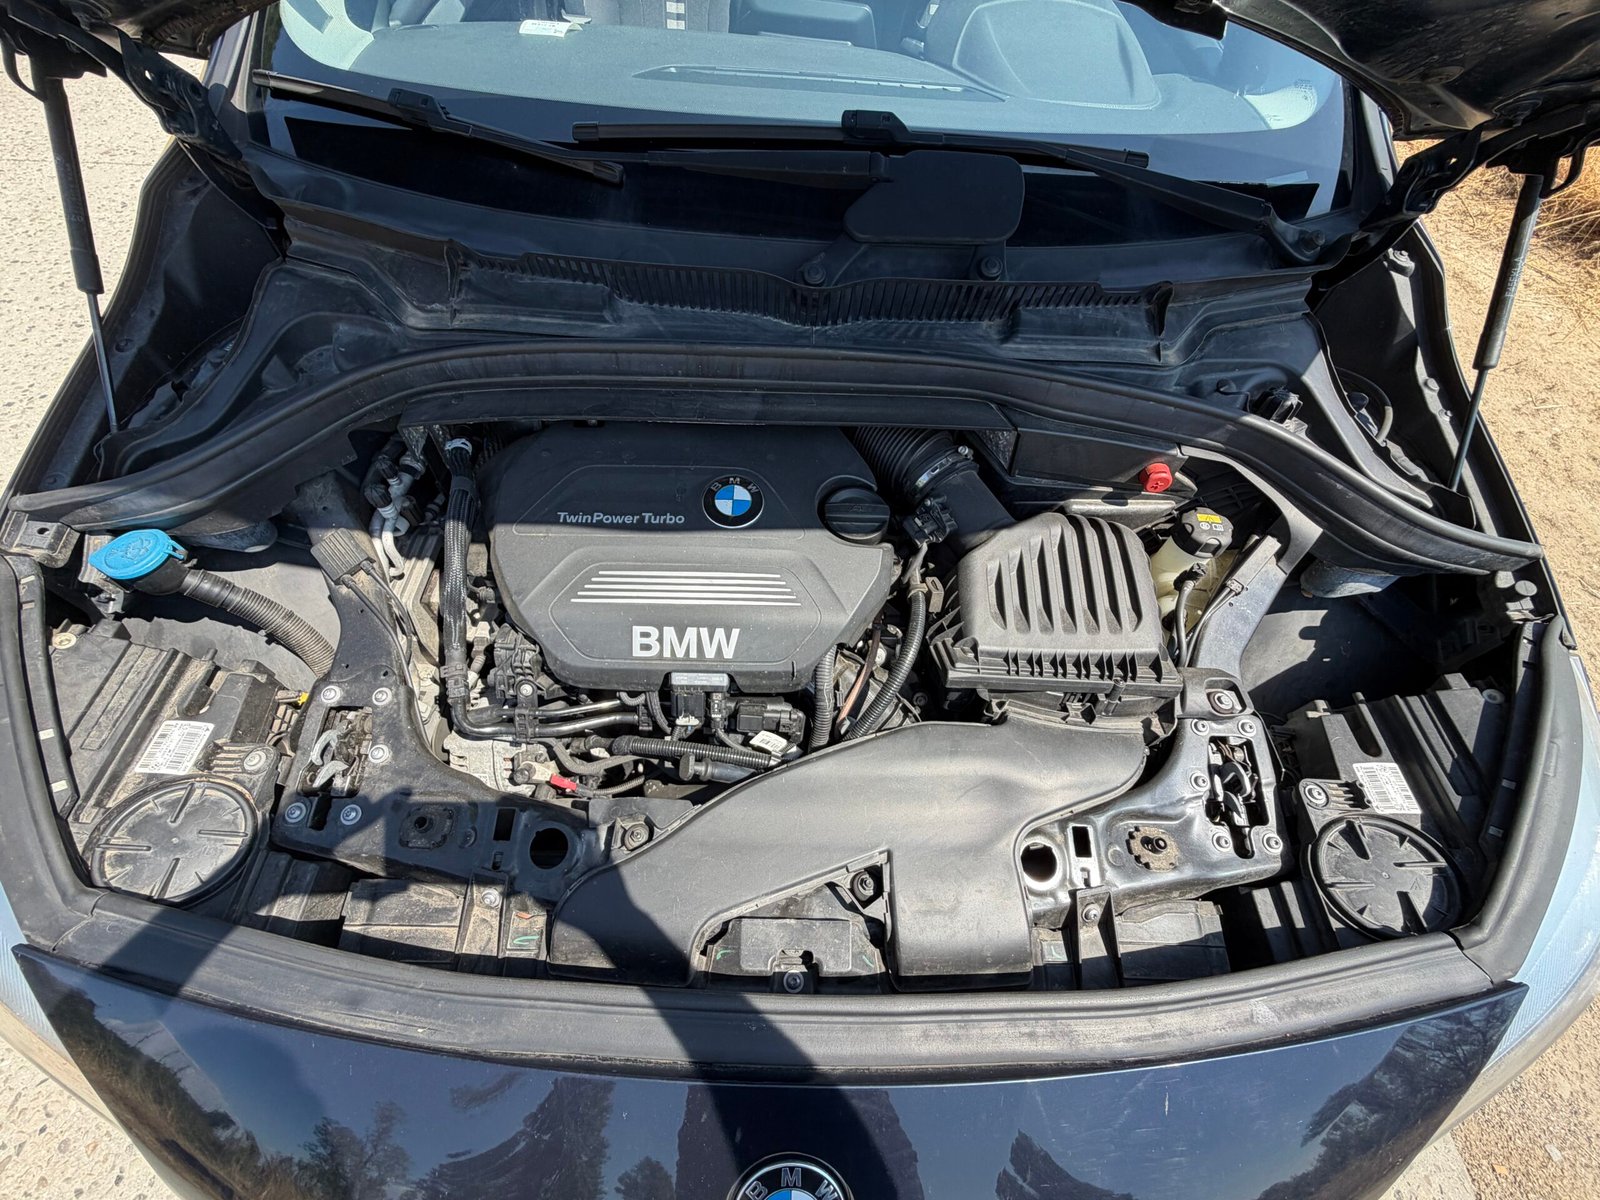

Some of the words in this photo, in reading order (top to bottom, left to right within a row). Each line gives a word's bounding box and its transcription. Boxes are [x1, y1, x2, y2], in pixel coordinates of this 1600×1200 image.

[710, 477, 760, 493] BMW
[556, 512, 640, 524] TwinPower
[641, 512, 686, 524] Turbo
[632, 625, 741, 659] BMW
[745, 1167, 838, 1200] BMW
